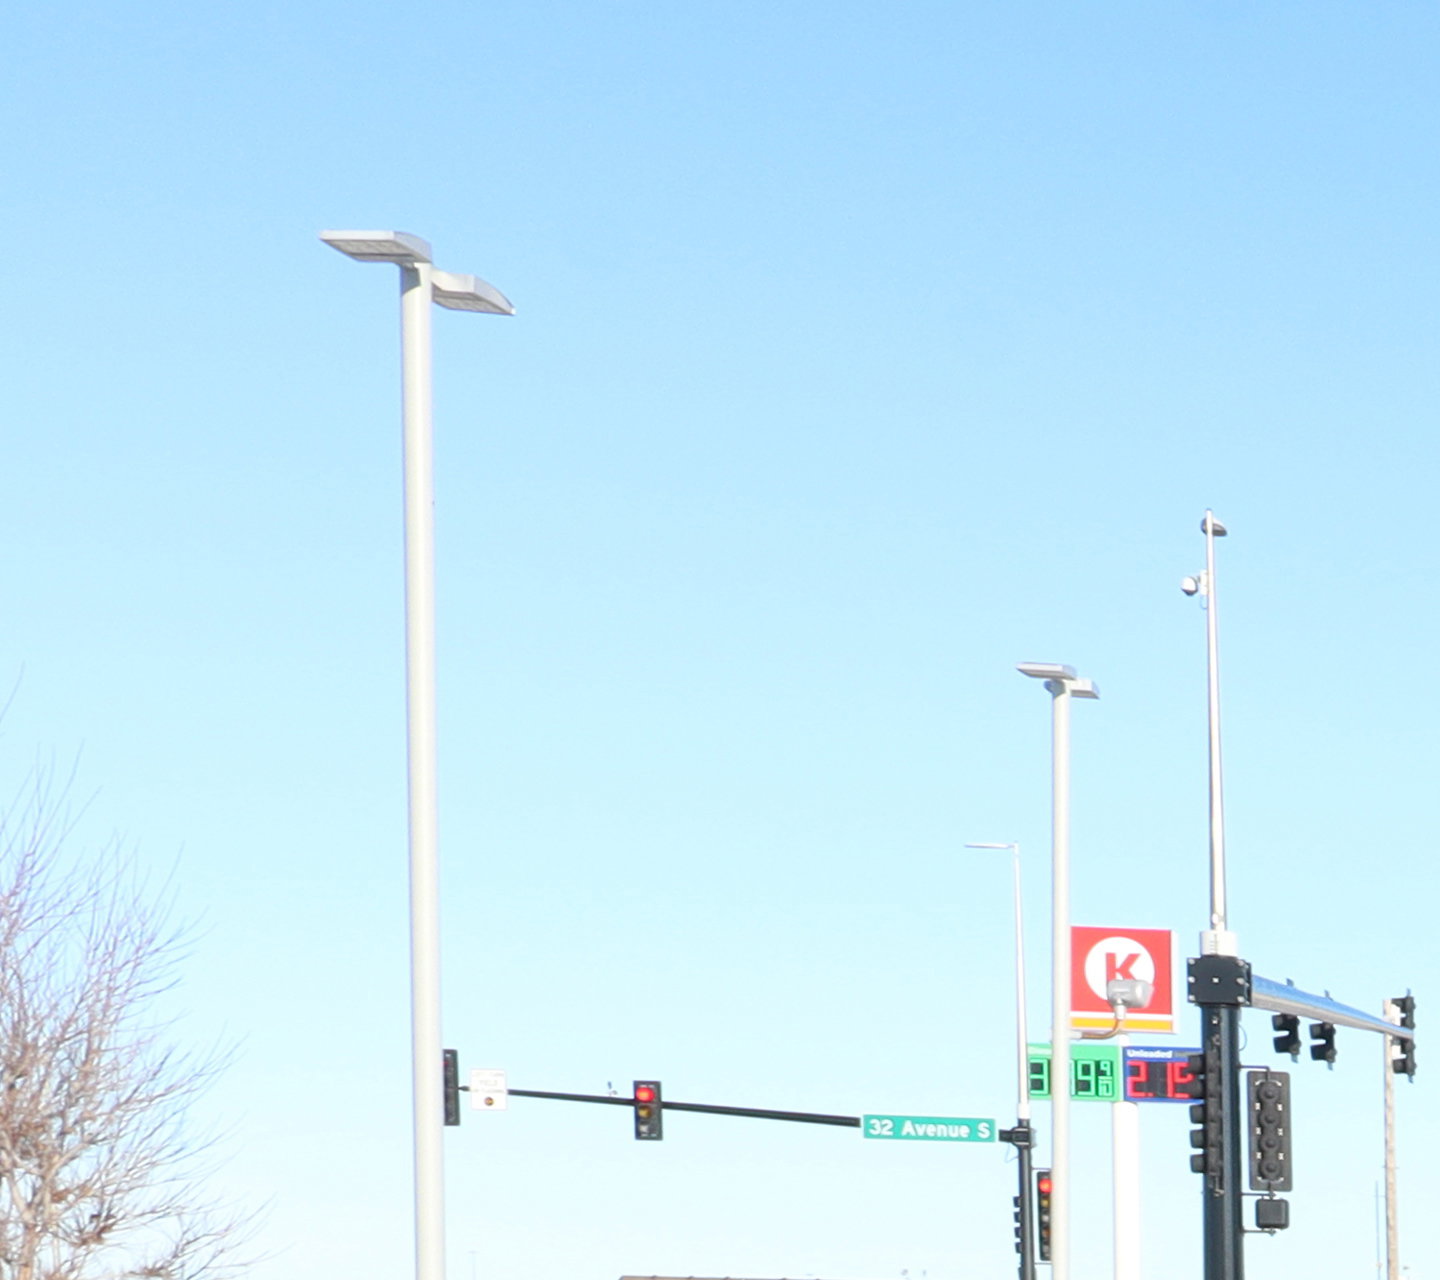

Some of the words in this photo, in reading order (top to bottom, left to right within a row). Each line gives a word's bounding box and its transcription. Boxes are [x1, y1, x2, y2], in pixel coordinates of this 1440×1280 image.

[1104, 952, 1142, 988] K
[1127, 1049, 1173, 1059] Unleaded
[869, 1119, 893, 1136] 32
[901, 1120, 970, 1138] Avenue
[978, 1122, 991, 1139] S
